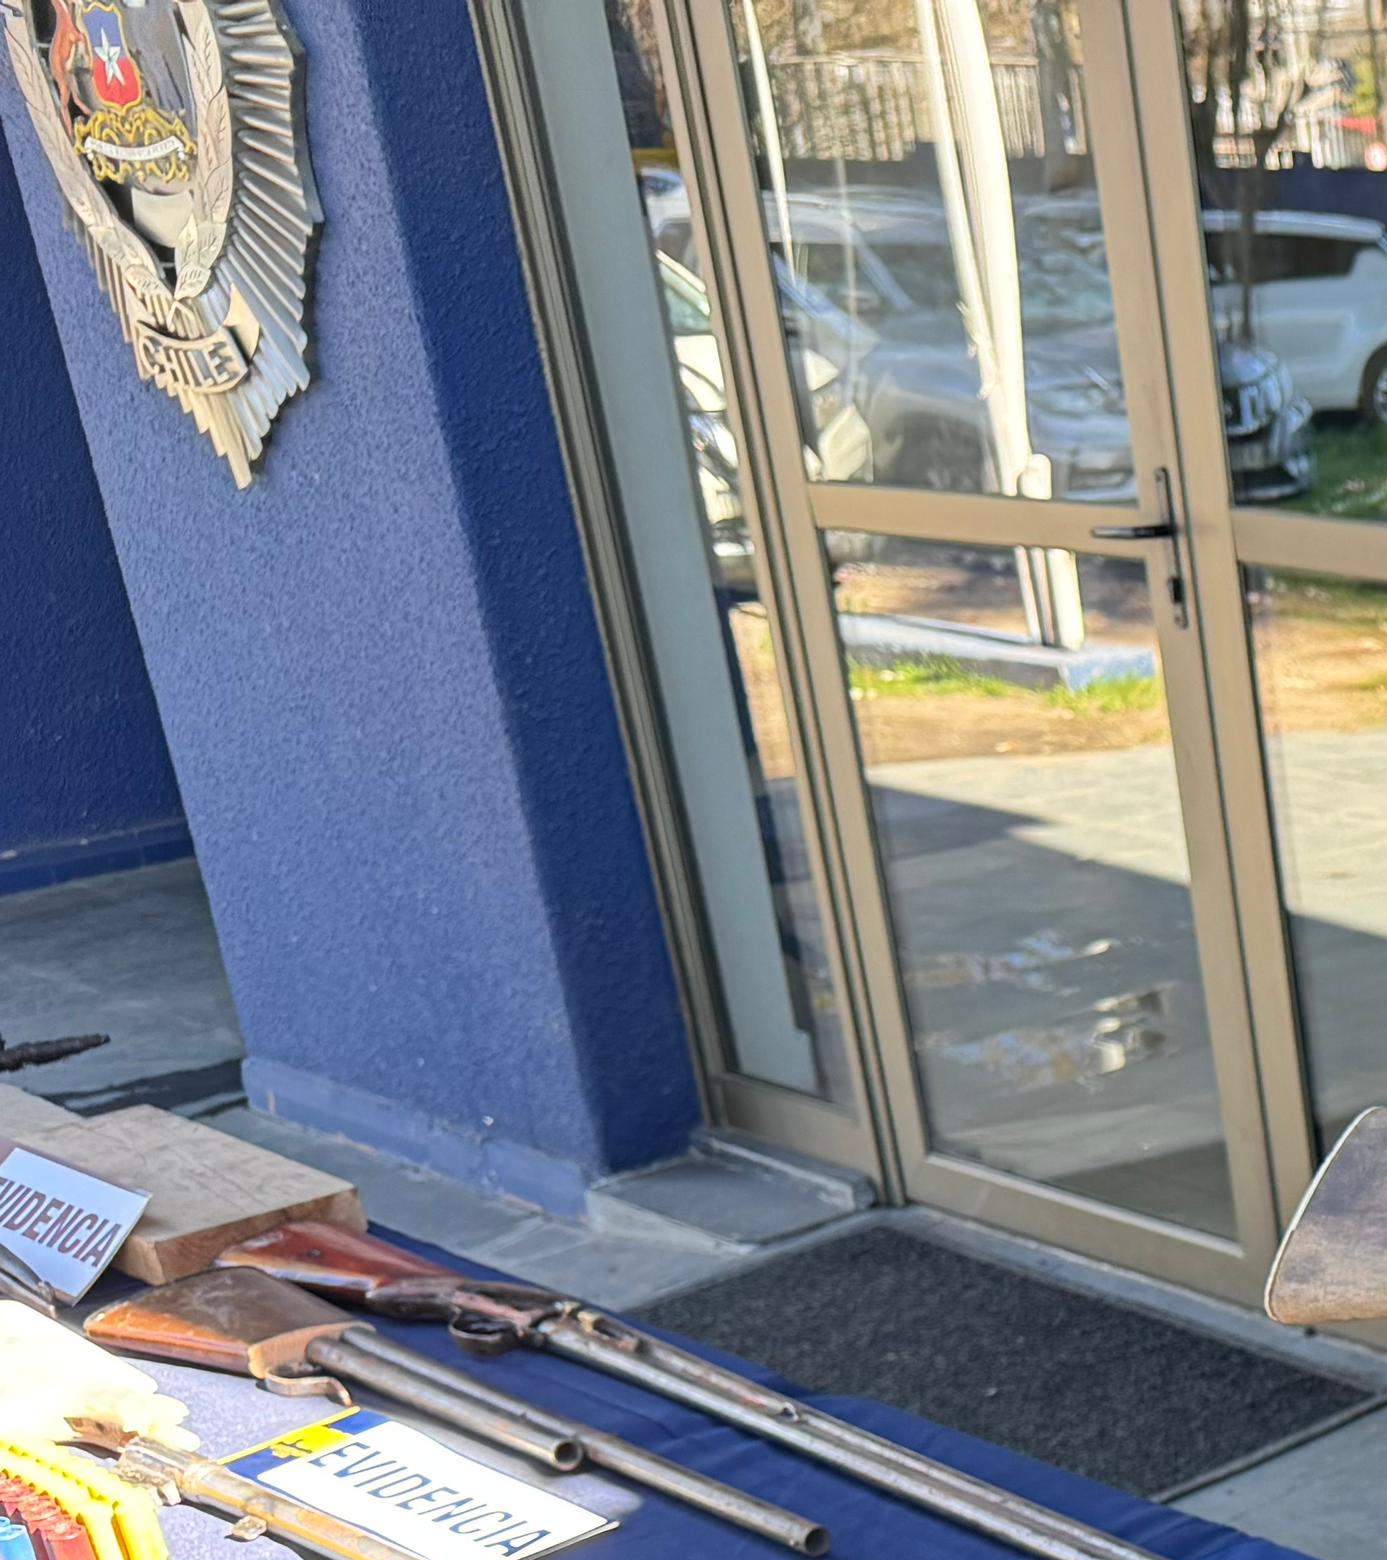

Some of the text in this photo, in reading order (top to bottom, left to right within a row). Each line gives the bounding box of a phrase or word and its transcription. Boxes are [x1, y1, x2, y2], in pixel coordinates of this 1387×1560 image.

[140, 335, 236, 388] CHILE
[0, 1176, 122, 1268] VIDENCIA
[308, 1441, 552, 1558] EVIDENCIA
